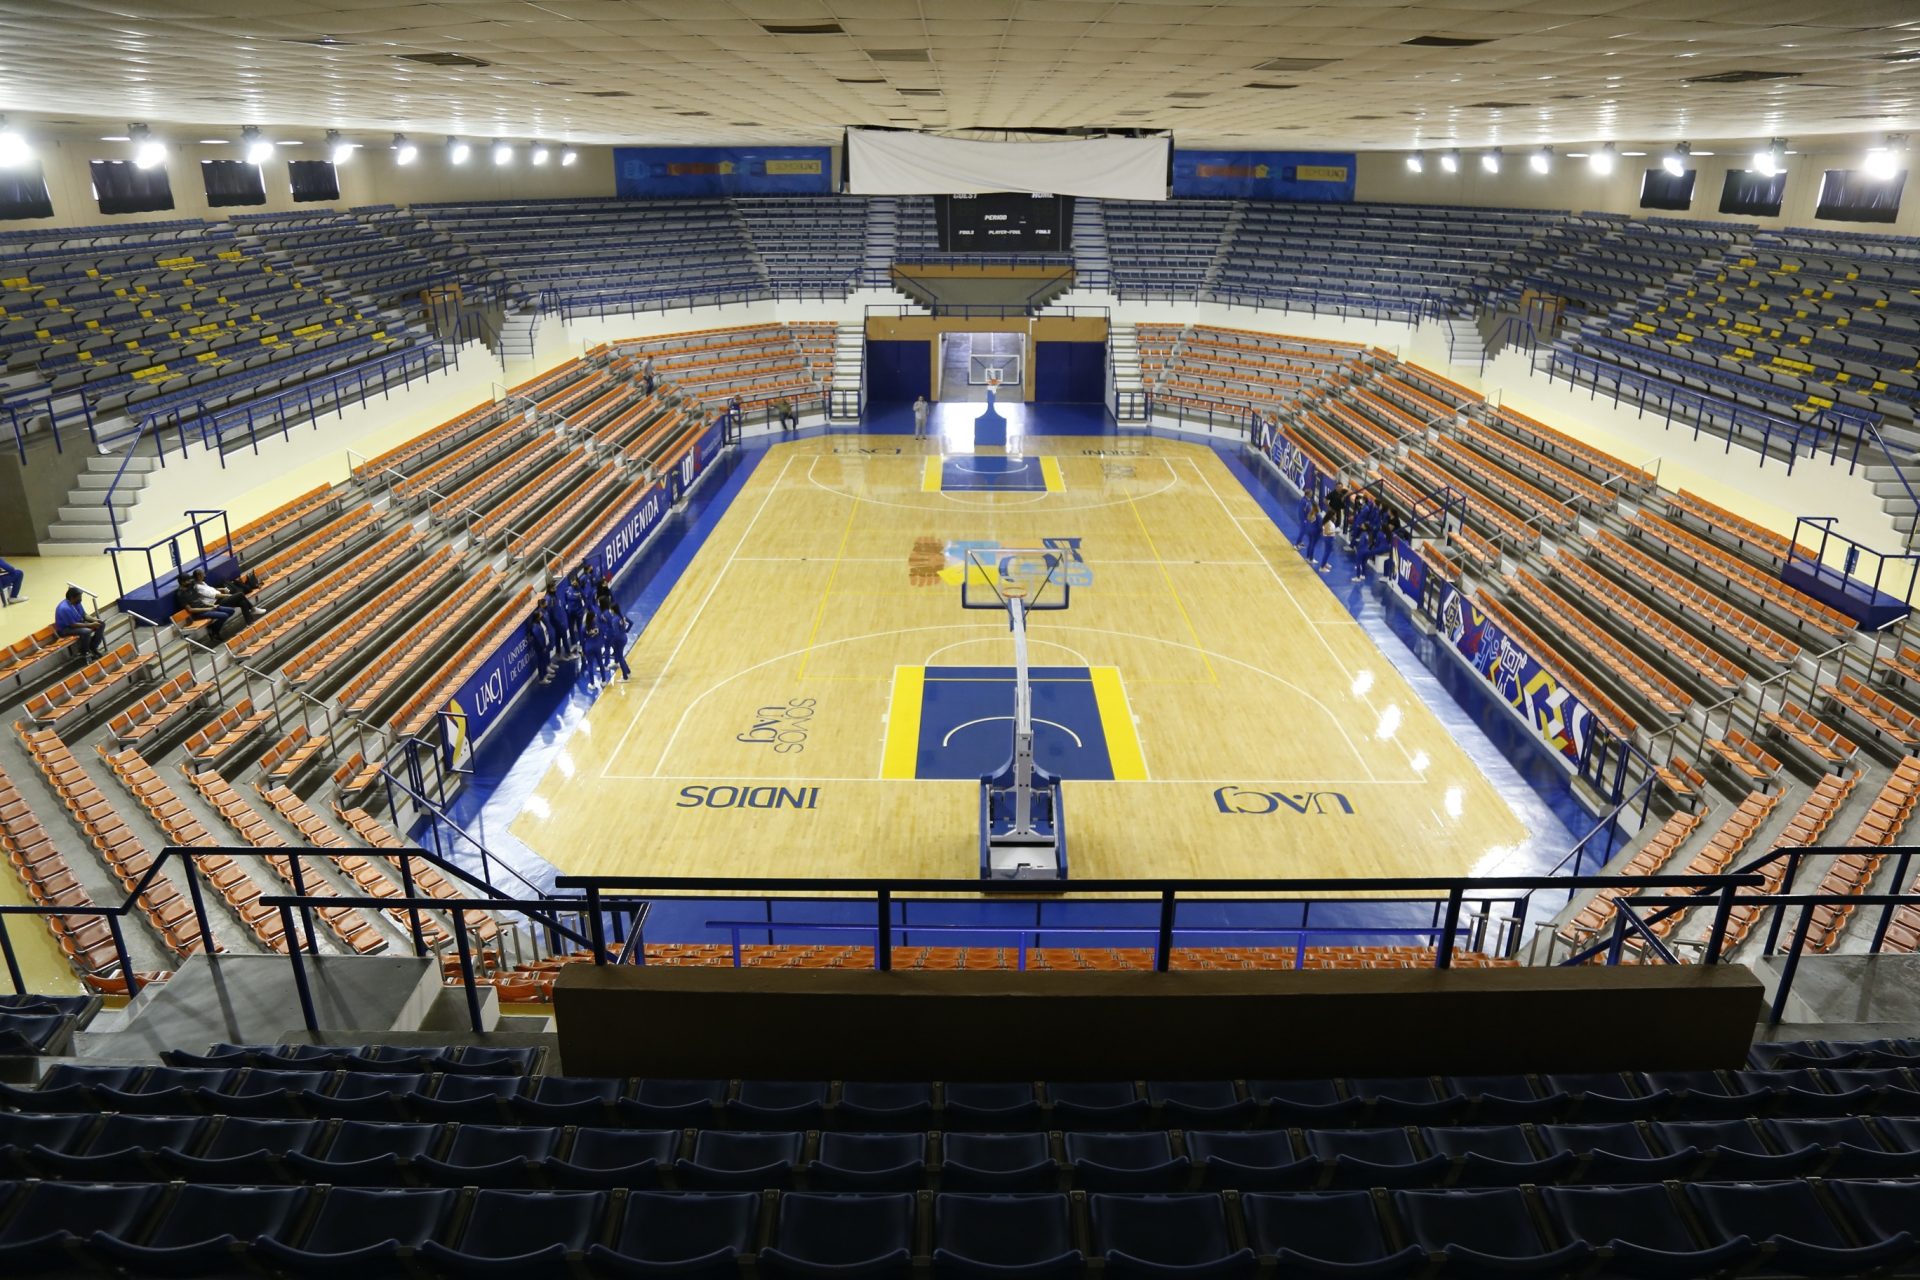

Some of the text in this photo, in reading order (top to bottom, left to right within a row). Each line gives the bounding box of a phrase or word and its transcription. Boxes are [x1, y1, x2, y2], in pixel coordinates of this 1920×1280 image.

[605, 494, 660, 570] BIENVENIDA
[475, 667, 504, 716] UACJ
[774, 698, 817, 753] SOMOS
[676, 785, 822, 809] INDIOS
[1213, 785, 1355, 814] UACJ
